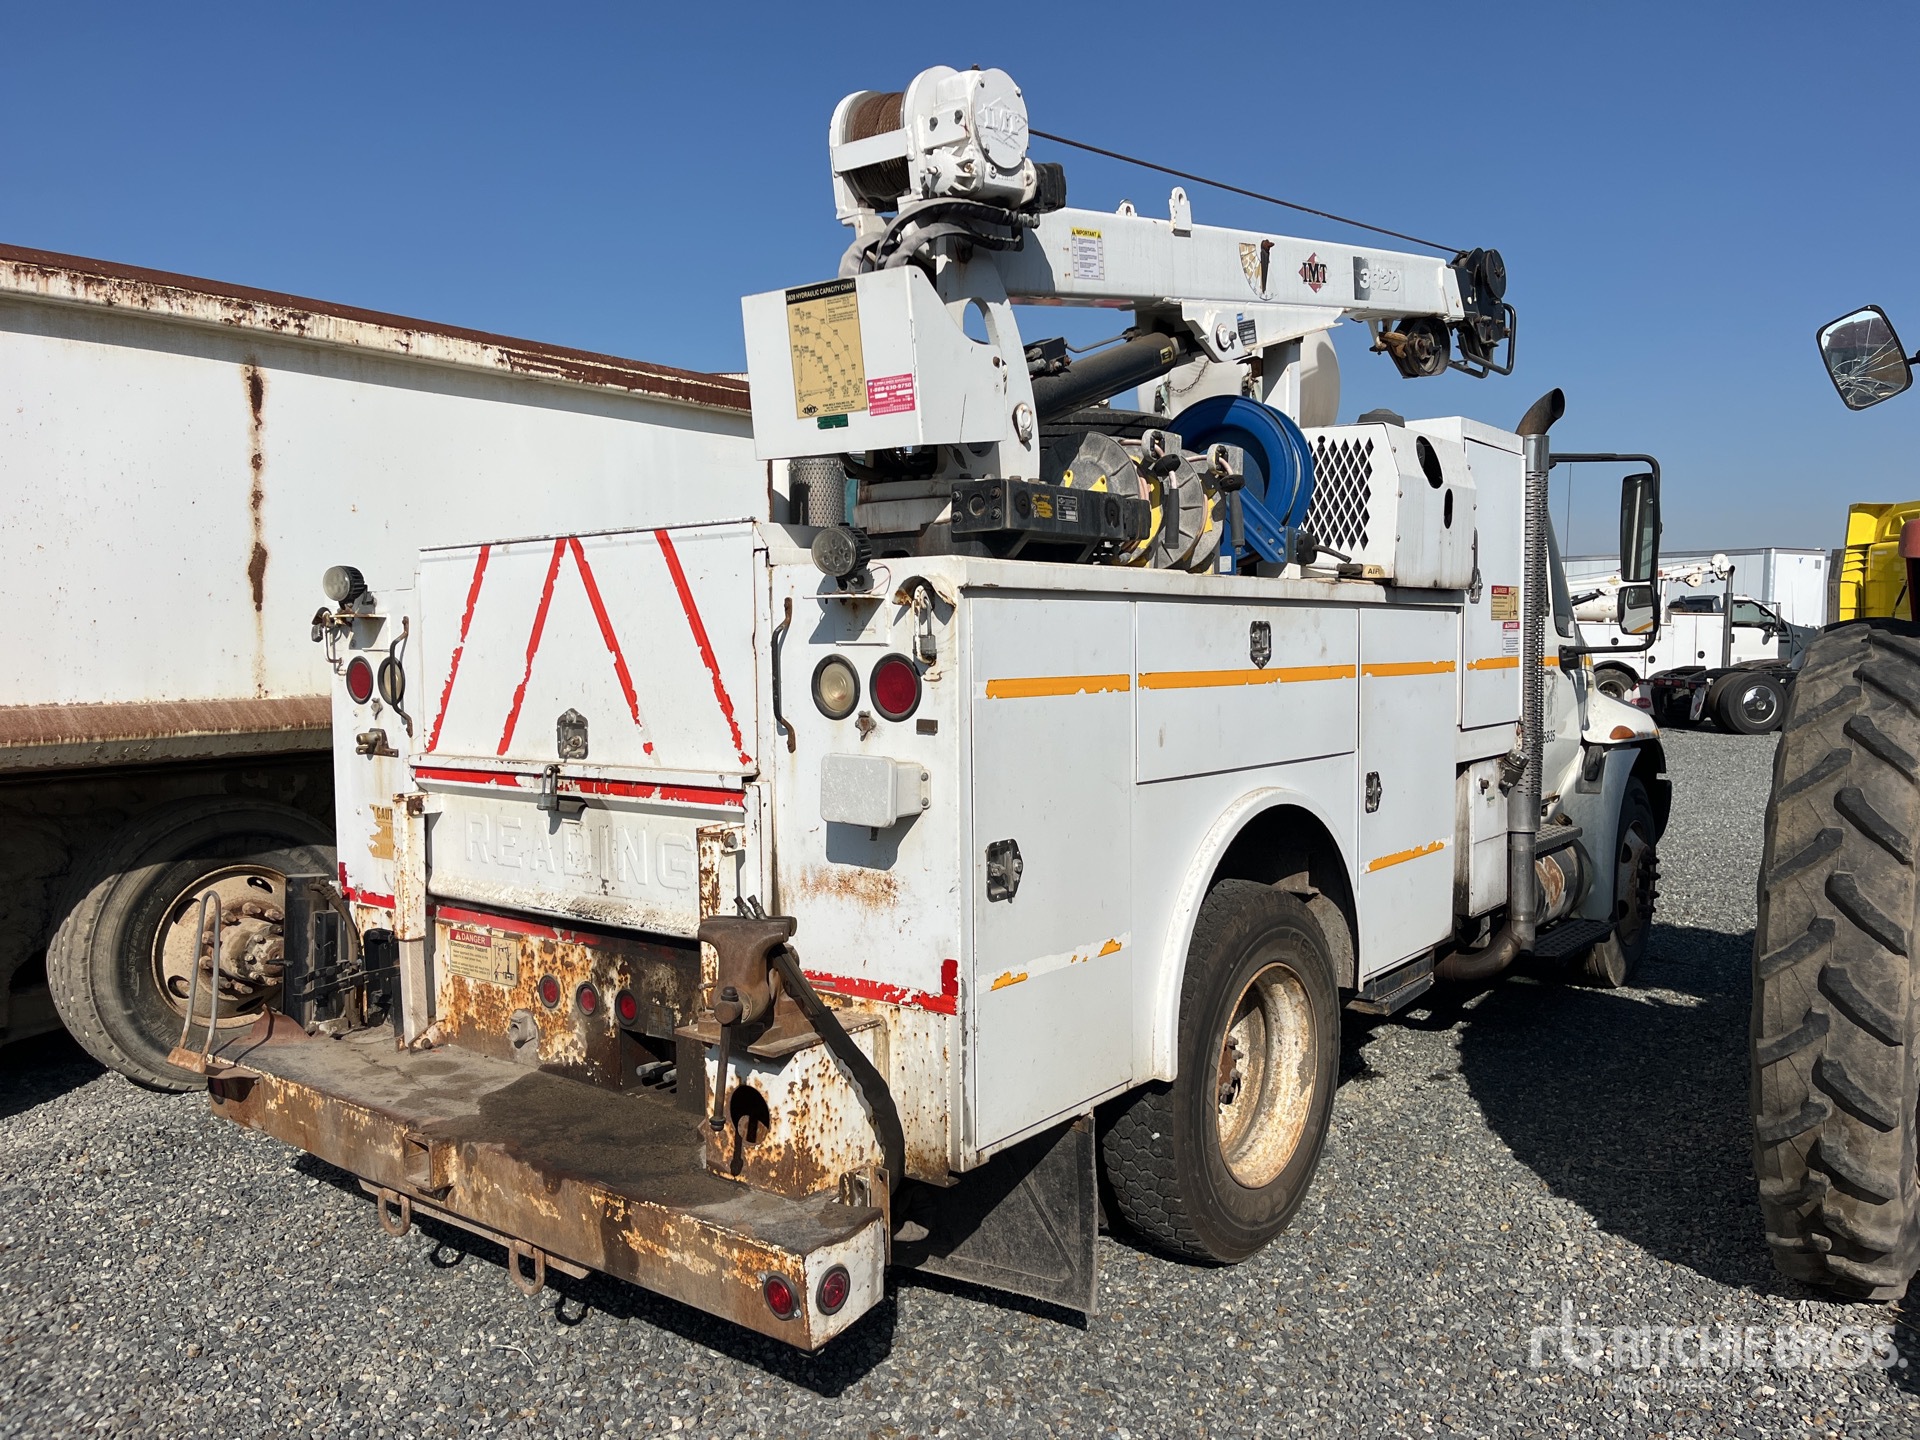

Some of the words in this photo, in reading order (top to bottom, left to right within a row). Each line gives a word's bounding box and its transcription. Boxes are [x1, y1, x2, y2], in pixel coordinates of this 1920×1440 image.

[1076, 229, 1097, 238] IMPORTANT
[1302, 262, 1328, 284] IMT
[796, 288, 820, 300] HYDRAULIC
[820, 284, 841, 295] CAPACITY
[840, 281, 855, 292] CHART
[1367, 567, 1382, 576] AIR
[463, 811, 695, 891] READING
[461, 932, 486, 945] DANGER
